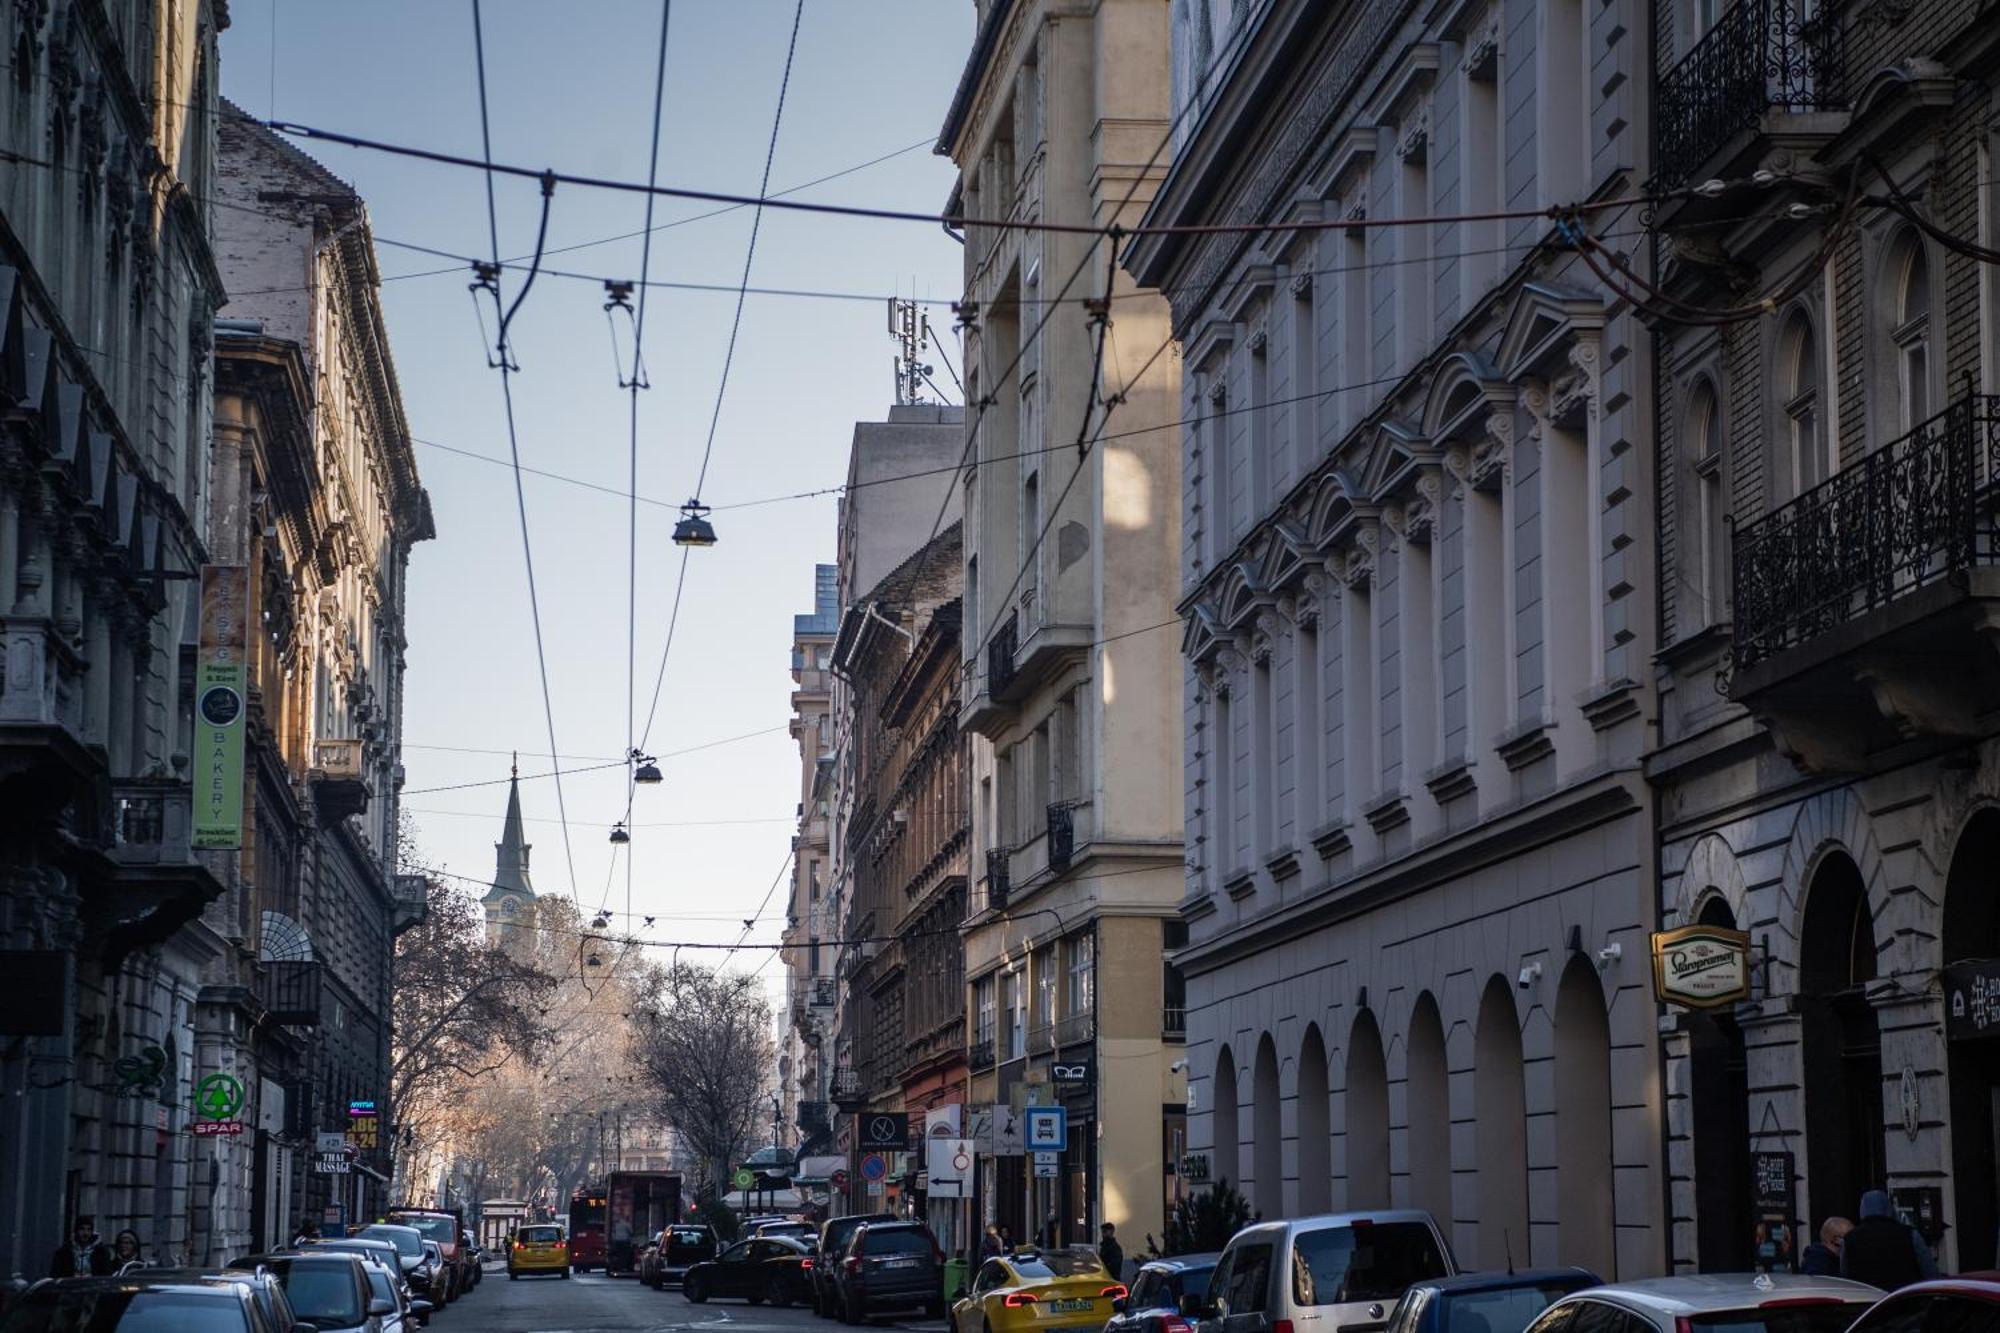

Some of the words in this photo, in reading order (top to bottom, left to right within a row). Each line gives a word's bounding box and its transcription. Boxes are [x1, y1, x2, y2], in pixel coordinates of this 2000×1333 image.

[212, 732, 225, 820] BAKERY
[1671, 951, 1737, 976] Staropramen
[194, 1123, 241, 1134] SPAR
[323, 1153, 345, 1161] THAI
[315, 1162, 351, 1173] MASSAGE
